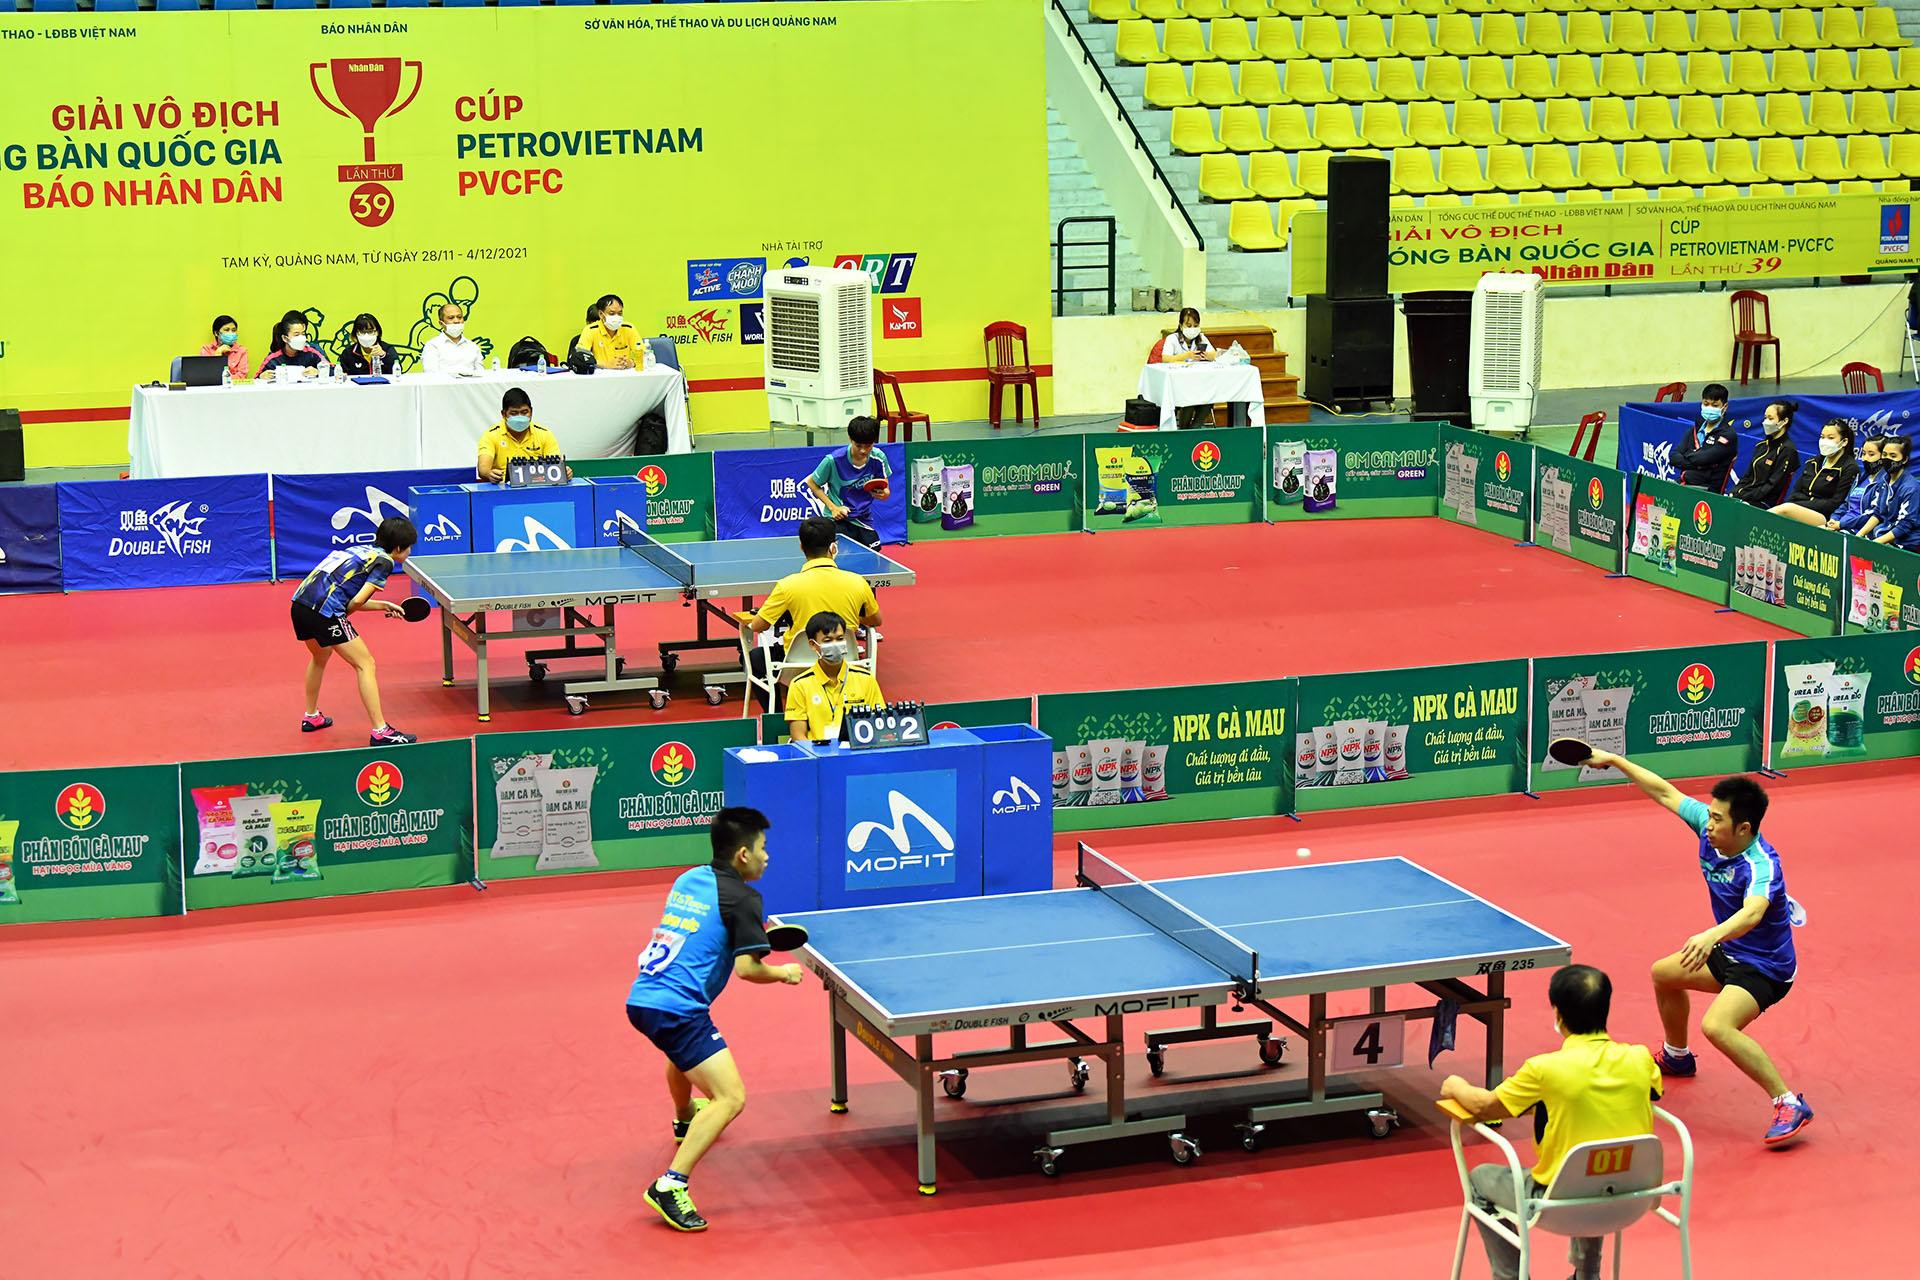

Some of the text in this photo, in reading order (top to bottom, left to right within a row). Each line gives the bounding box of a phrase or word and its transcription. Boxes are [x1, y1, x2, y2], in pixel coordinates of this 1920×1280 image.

[321, 21, 408, 35] BÁO NHÂN DÂN
[584, 15, 837, 31] SỞ VĂN HÓA, THỂ THAO VÀ DU LỊCH QUẢNG NAM
[2, 27, 136, 40] THAO LĐBB VIỆT NAM
[455, 88, 523, 122] CÚP
[52, 95, 279, 134] GIẢI VÔ ĐỊCH
[37, 130, 283, 170] BÀN QUỐC GIA
[457, 127, 703, 159] PETROVIETNAM
[346, 166, 397, 181] LẦN THỨ
[458, 168, 563, 197] PVCFC
[23, 170, 283, 209] BÁO NHÂN DÂN
[353, 192, 391, 219] 39
[1604, 208, 1623, 216] NAM
[1818, 201, 1837, 210] NAM
[1440, 223, 1563, 240] VÔ ĐỊCH
[1670, 217, 1700, 234] CÚP
[762, 239, 823, 251] NHÀ TÀI TRỢ
[1459, 238, 1654, 263] BÀN QUỐC GIA
[1670, 238, 1834, 257] PETROVIETNAM PVCFC
[222, 247, 527, 269] TAM KỲ, QUẢNG NAM, TỪ NGÀY 28/11 4/12/2021
[1671, 257, 1782, 276] LẦN THỨ 39
[1532, 264, 1600, 280] Nhân
[1605, 262, 1654, 277] Dân
[692, 283, 721, 296] ACTIVE
[890, 321, 916, 330] KAMITO
[712, 333, 733, 342] FISH
[1370, 450, 1427, 468] CAMAU
[514, 465, 561, 483] 1 0
[1007, 463, 1062, 482] CAMAU
[1397, 470, 1424, 479] GREEN
[770, 478, 797, 499] 双魚
[1034, 483, 1060, 492] GREEN
[1171, 474, 1241, 492] PHÂN BÓN MAU
[659, 499, 690, 516] CÀ MAU
[760, 505, 812, 523] DOUBLE
[120, 510, 148, 531] 双魚
[109, 538, 211, 556] DOUBLE FISH
[1789, 542, 1839, 579] NPK CÀ MAU
[495, 603, 517, 611] DOUBLE
[585, 593, 656, 606] MOFIT
[1413, 685, 1518, 722] NPK CÀ MAU
[1878, 692, 1906, 714] PHÂN
[854, 716, 920, 743] 0 2
[1173, 705, 1286, 743] NPK CÀ MAU
[1650, 707, 1742, 734] PHÂN BÓN CÀ MAU
[1425, 723, 1505, 746] Chất lượng đi đầu,
[1656, 730, 1732, 745] HẠT NGỌC MÙA VÀNG
[1186, 744, 1271, 767] Chất lượng đi đầu,
[1321, 748, 1338, 757] NPK
[1343, 742, 1361, 752] NPK
[1364, 743, 1380, 753] NPK
[1387, 746, 1402, 754] NPK
[1434, 744, 1496, 766] Giá trị bền lâu
[1299, 752, 1315, 762] NPK
[1074, 768, 1092, 777] NPK
[1098, 762, 1117, 772] NPK
[1120, 763, 1138, 773] NPK
[1145, 766, 1161, 774] NPK
[1195, 765, 1262, 787] Giá trị bền lâu
[619, 790, 700, 818] PHÂN BÓN CÀ
[992, 804, 1041, 815] MOFIT
[323, 810, 438, 840] PHÂN BÓN CÀ MAU
[628, 816, 692, 832] HẠT NGỌC MÙA
[22, 834, 142, 863] PHÂN BÓN CÀ MAU
[334, 833, 428, 853] HẠT NGỌC MÙA VÀNG
[33, 860, 132, 877] HẠT NGỌC MÙA VÀNG
[847, 852, 954, 874] MOFIT
[1511, 959, 1535, 970] 235
[954, 1018, 988, 1030] DOUBLE
[990, 1017, 1009, 1026] FISH
[1094, 993, 1200, 1017] MOFIT
[1352, 1022, 1384, 1065] 4
[1593, 1149, 1624, 1173] 01
